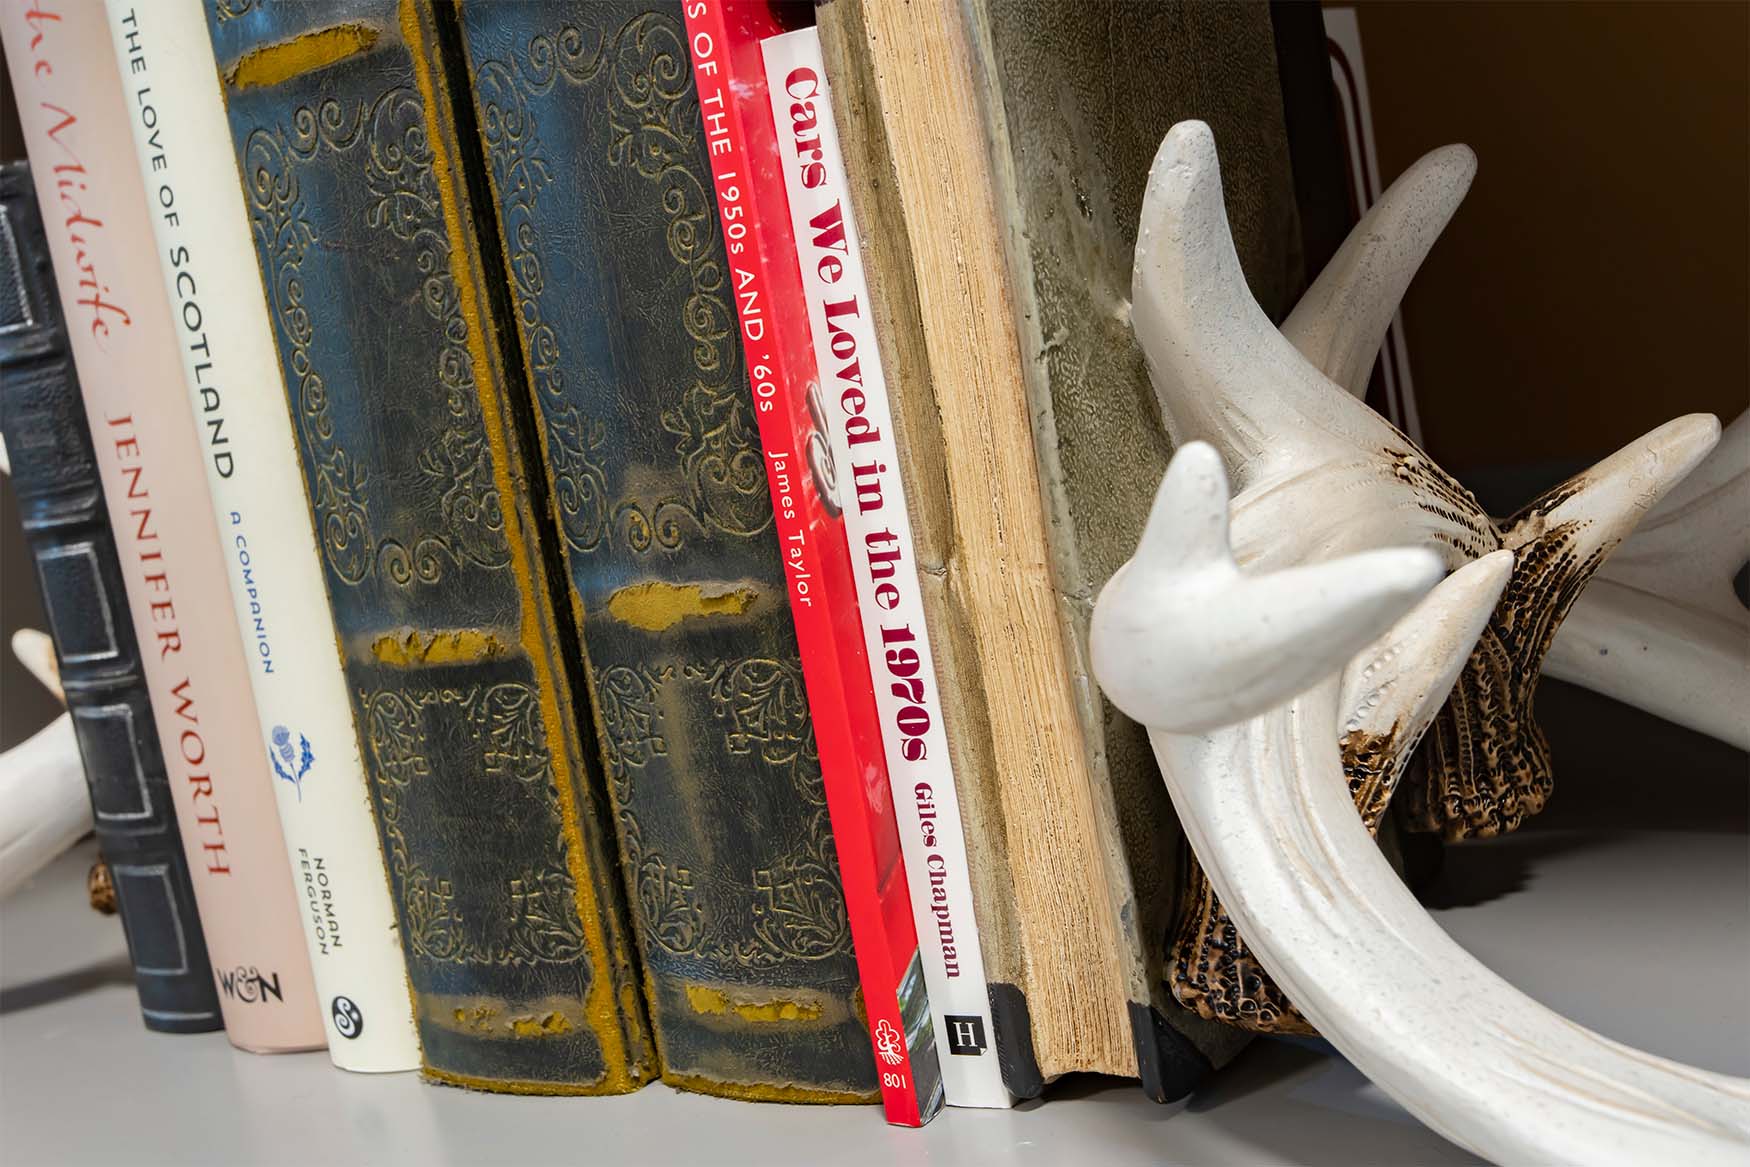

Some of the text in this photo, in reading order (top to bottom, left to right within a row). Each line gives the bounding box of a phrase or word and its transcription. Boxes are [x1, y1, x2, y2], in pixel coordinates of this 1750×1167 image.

[687, 0, 707, 19] S
[693, 32, 718, 76] OF
[703, 88, 732, 156] THE
[25, 0, 132, 346] he Midwife
[717, 171, 747, 255] 1950s
[122, 7, 234, 479] THE LOVE OF SCOTLAND
[735, 267, 764, 341] AND
[785, 67, 931, 762] Cars We Loved in the 1970s
[768, 450, 812, 607] James Taylor
[230, 511, 274, 674] A COMPANION
[105, 412, 231, 877] JENNIFER WORTH
[299, 847, 329, 955] FERGUSON
[314, 857, 342, 948] NORMAN
[914, 782, 961, 979] Giles Chapman
[883, 1073, 907, 1089] 801
[952, 1021, 977, 1047] H
